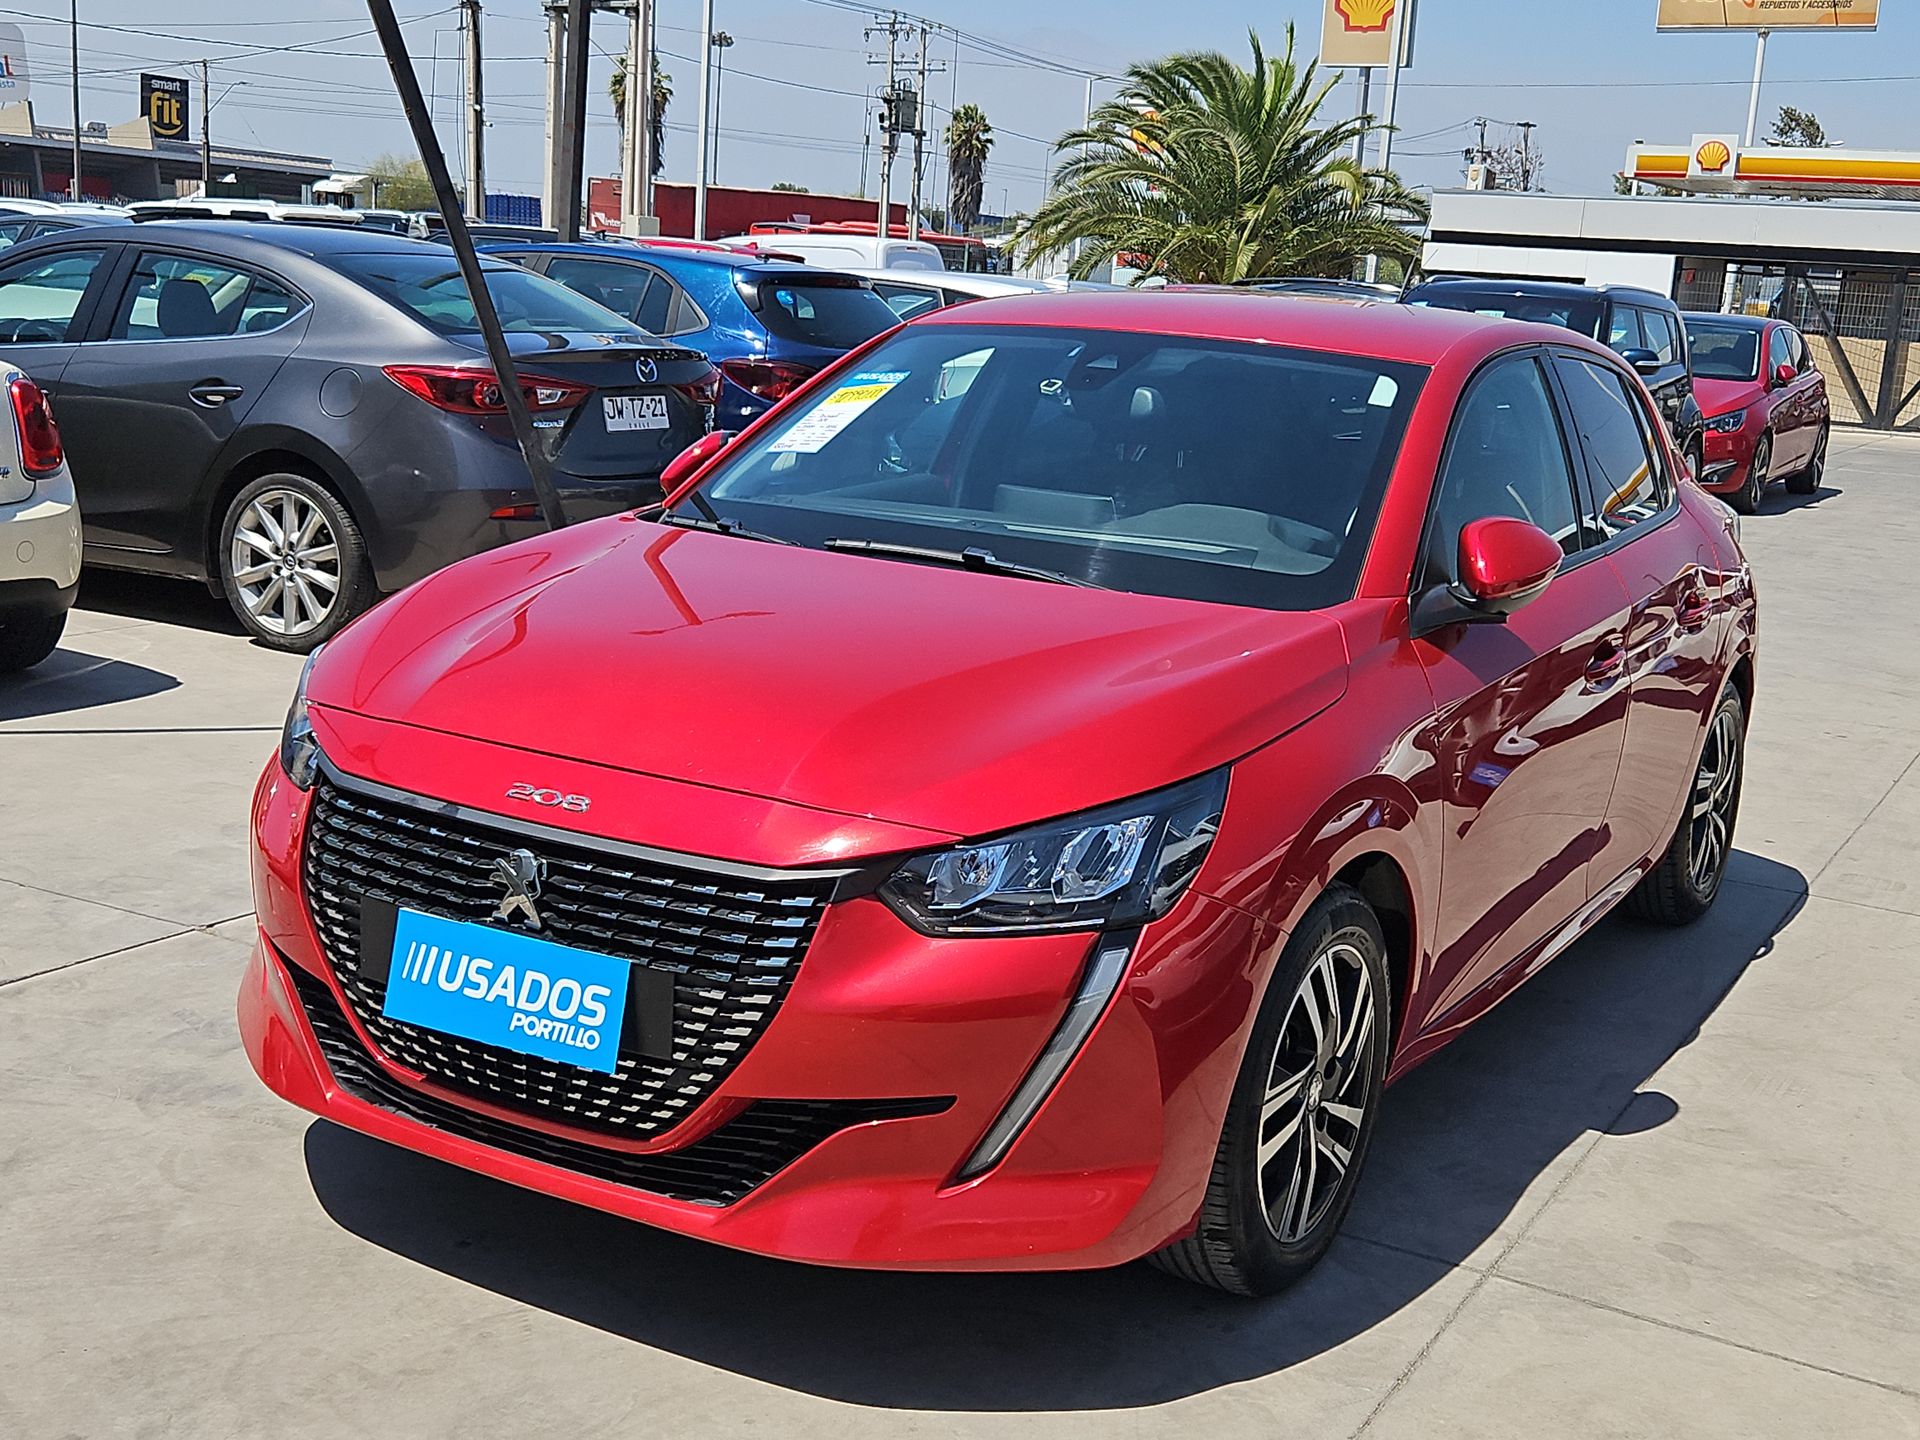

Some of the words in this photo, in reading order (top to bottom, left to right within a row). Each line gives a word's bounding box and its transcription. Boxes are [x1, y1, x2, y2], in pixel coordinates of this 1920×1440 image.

[1759, 0, 1799, 9] REPUESTOS
[1807, 0, 1853, 9] ACCESORIOS
[151, 79, 180, 91] smart
[151, 91, 181, 126] fit
[505, 781, 592, 813] 208
[437, 950, 612, 1027] USADOS
[509, 1012, 601, 1050] PORTILLO
